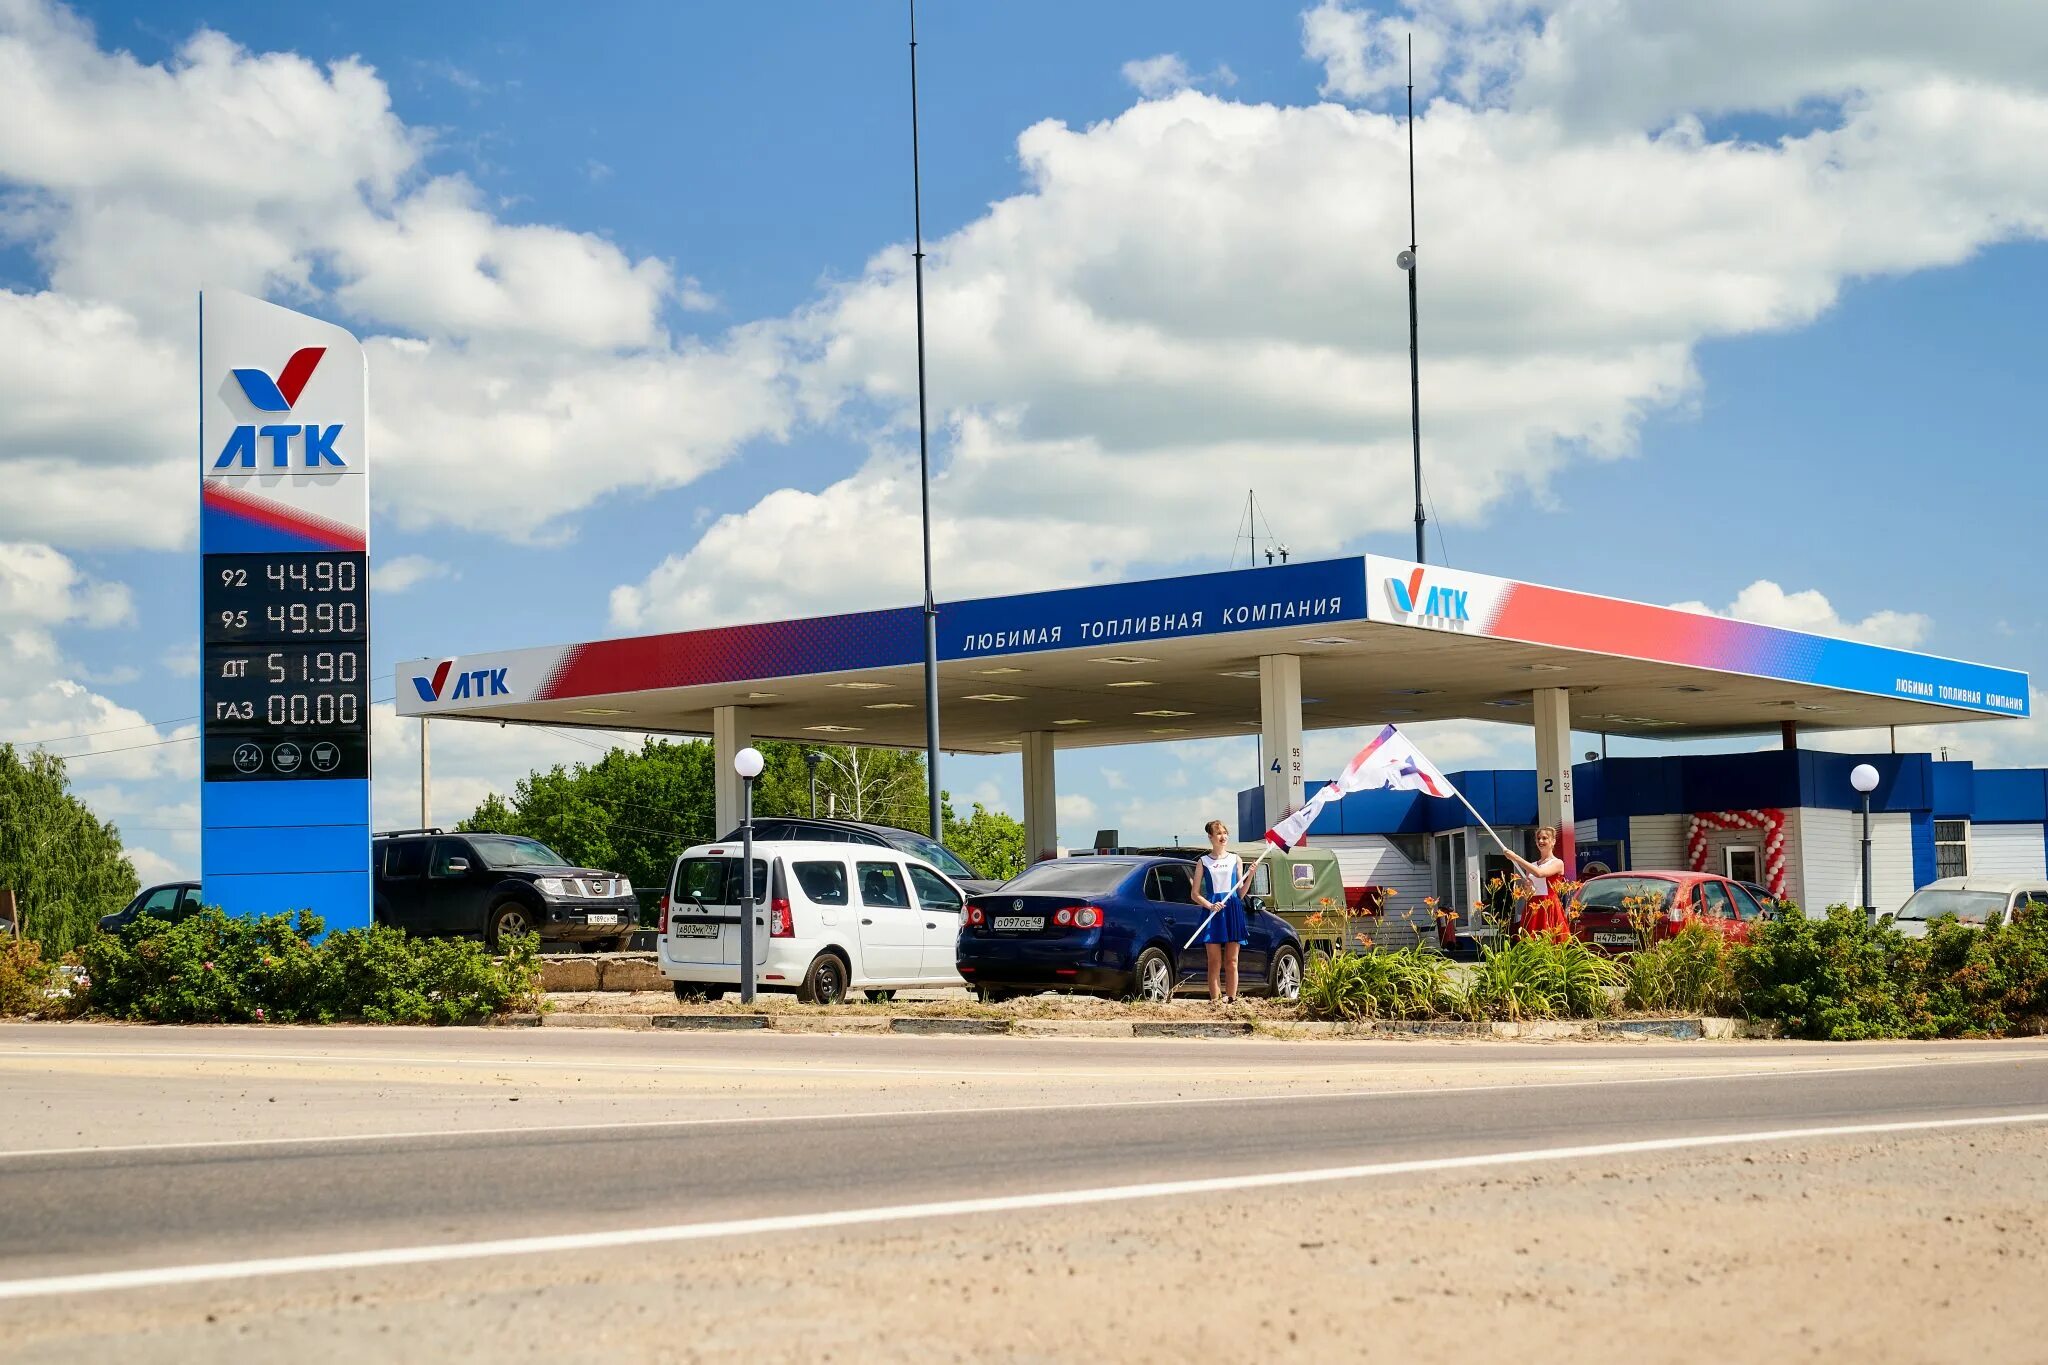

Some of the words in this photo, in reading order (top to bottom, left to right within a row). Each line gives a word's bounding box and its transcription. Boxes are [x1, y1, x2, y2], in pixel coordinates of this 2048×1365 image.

[221, 569, 248, 587] 92
[267, 561, 356, 592] 44.90
[221, 610, 248, 628] 95
[267, 602, 356, 633] 49.90
[963, 626, 1062, 651] ЛЮБИМАЯ
[1080, 611, 1203, 639] ТОПЛИВНАЯ
[1222, 596, 1342, 625] КОМПАНИЯ
[221, 659, 249, 678] ДТ
[267, 652, 357, 683] 51.90
[1896, 678, 1933, 697] ЛЮБИМАЯ
[1938, 685, 1981, 704] ТОПЛИВНАЯ
[1986, 693, 2023, 711] КОМПАНИЯ
[216, 701, 254, 720] ГАЗ
[267, 693, 357, 725] 00.00
[239, 749, 258, 763] 24
[1292, 747, 1300, 757] 95
[1270, 757, 1282, 774] 4
[1292, 762, 1301, 771] 92
[1292, 775, 1301, 786] ДТ
[1563, 769, 1570, 779] 95
[1544, 778, 1554, 793] 2
[1563, 782, 1571, 791] 92
